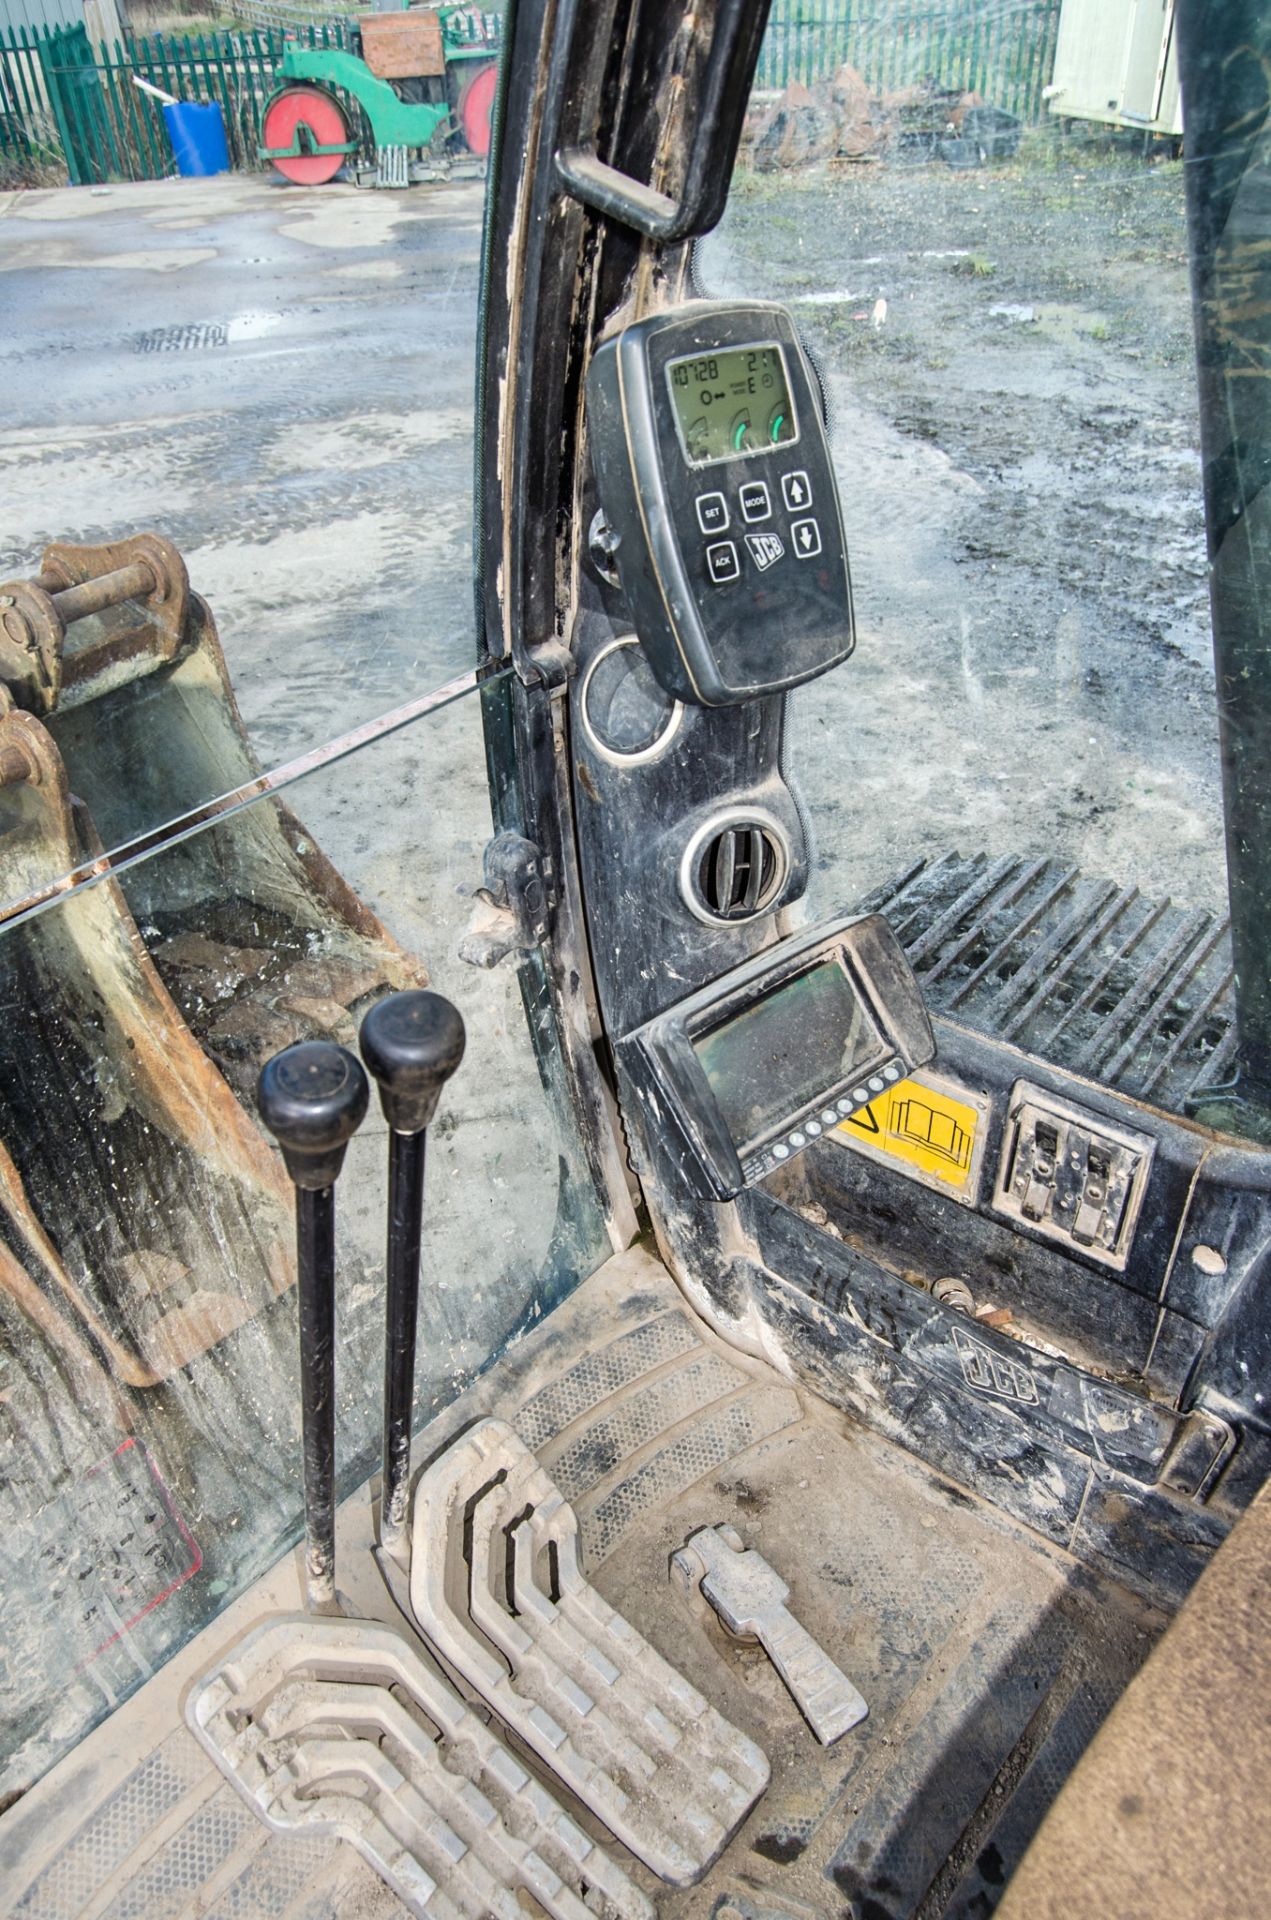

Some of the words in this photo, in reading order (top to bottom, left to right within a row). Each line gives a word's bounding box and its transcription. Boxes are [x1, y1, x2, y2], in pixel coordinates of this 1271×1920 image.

[745, 496, 766, 507] MODE
[705, 508, 720, 518] SET
[751, 535, 784, 567] JCB
[715, 556, 731, 568] ACK
